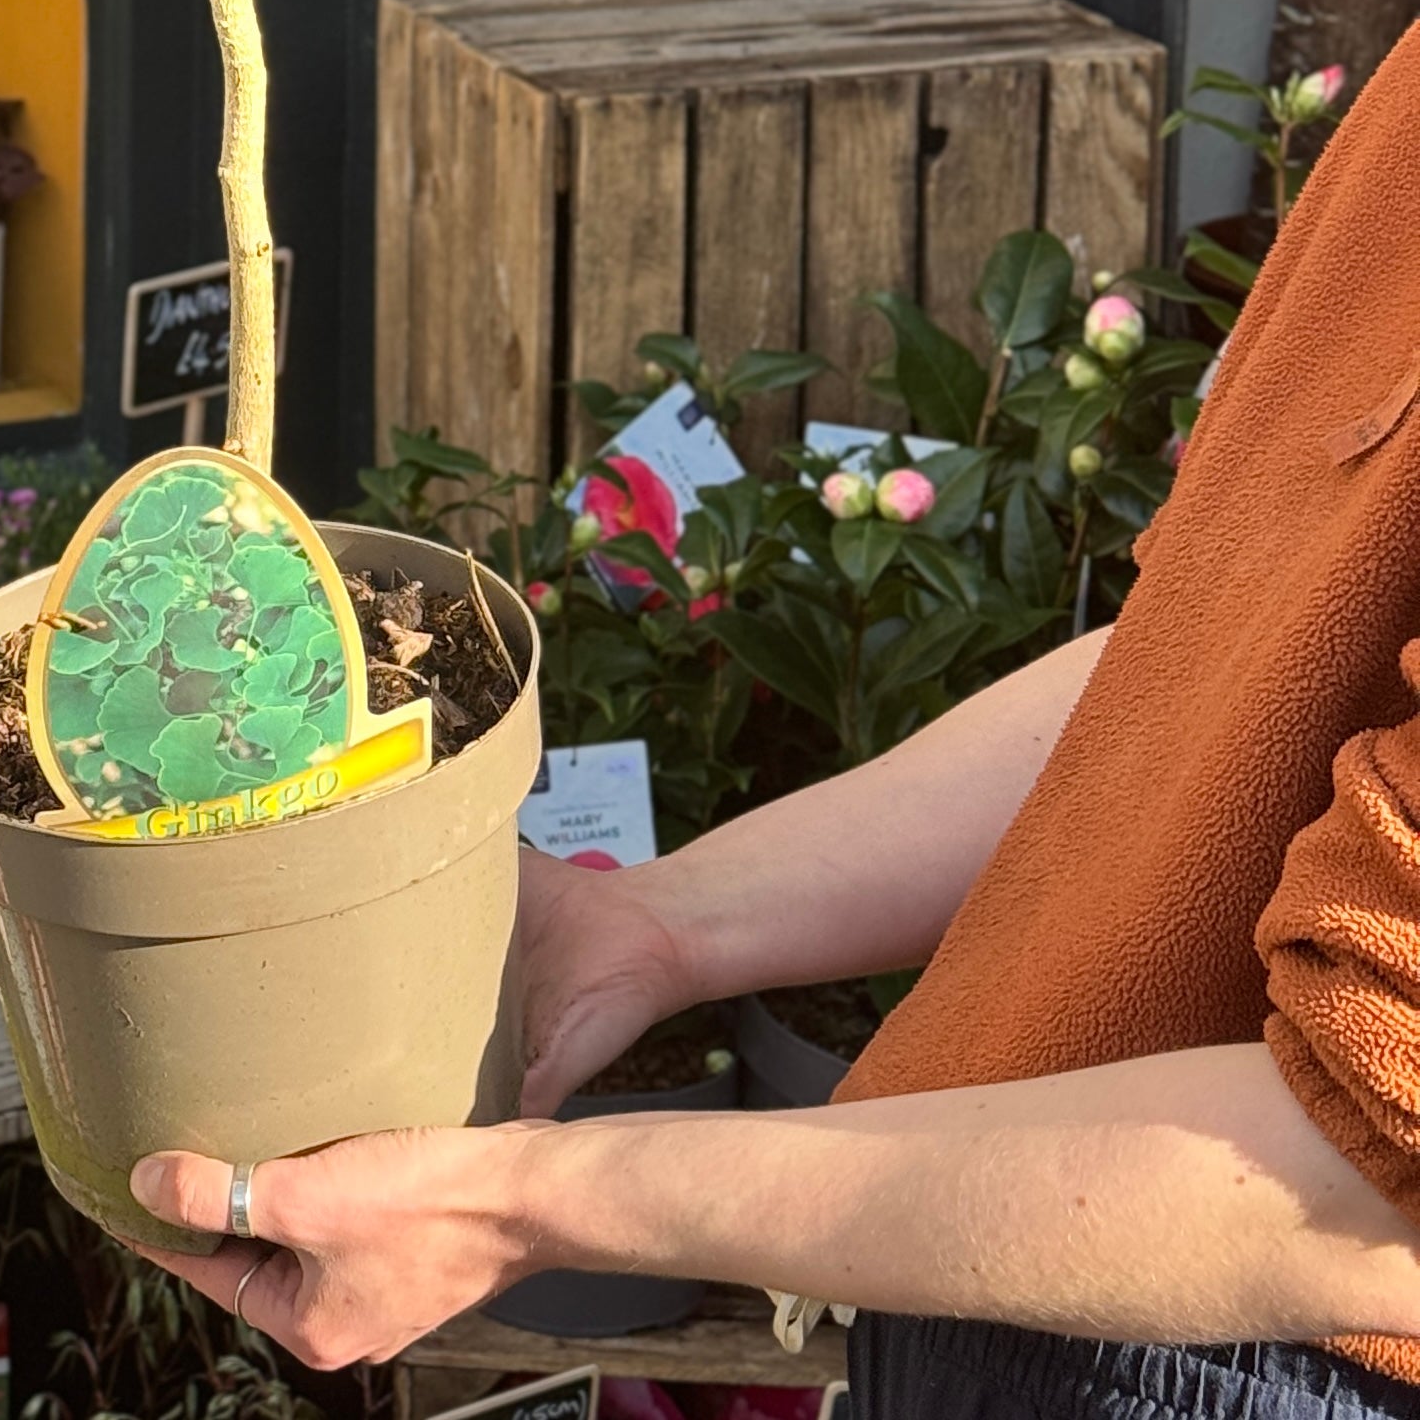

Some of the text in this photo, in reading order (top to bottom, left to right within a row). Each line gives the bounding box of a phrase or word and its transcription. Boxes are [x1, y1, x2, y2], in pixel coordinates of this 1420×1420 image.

[136, 766, 339, 840] Ginkgo
[559, 812, 604, 830] MARY
[544, 826, 622, 846] WILLIAMS
